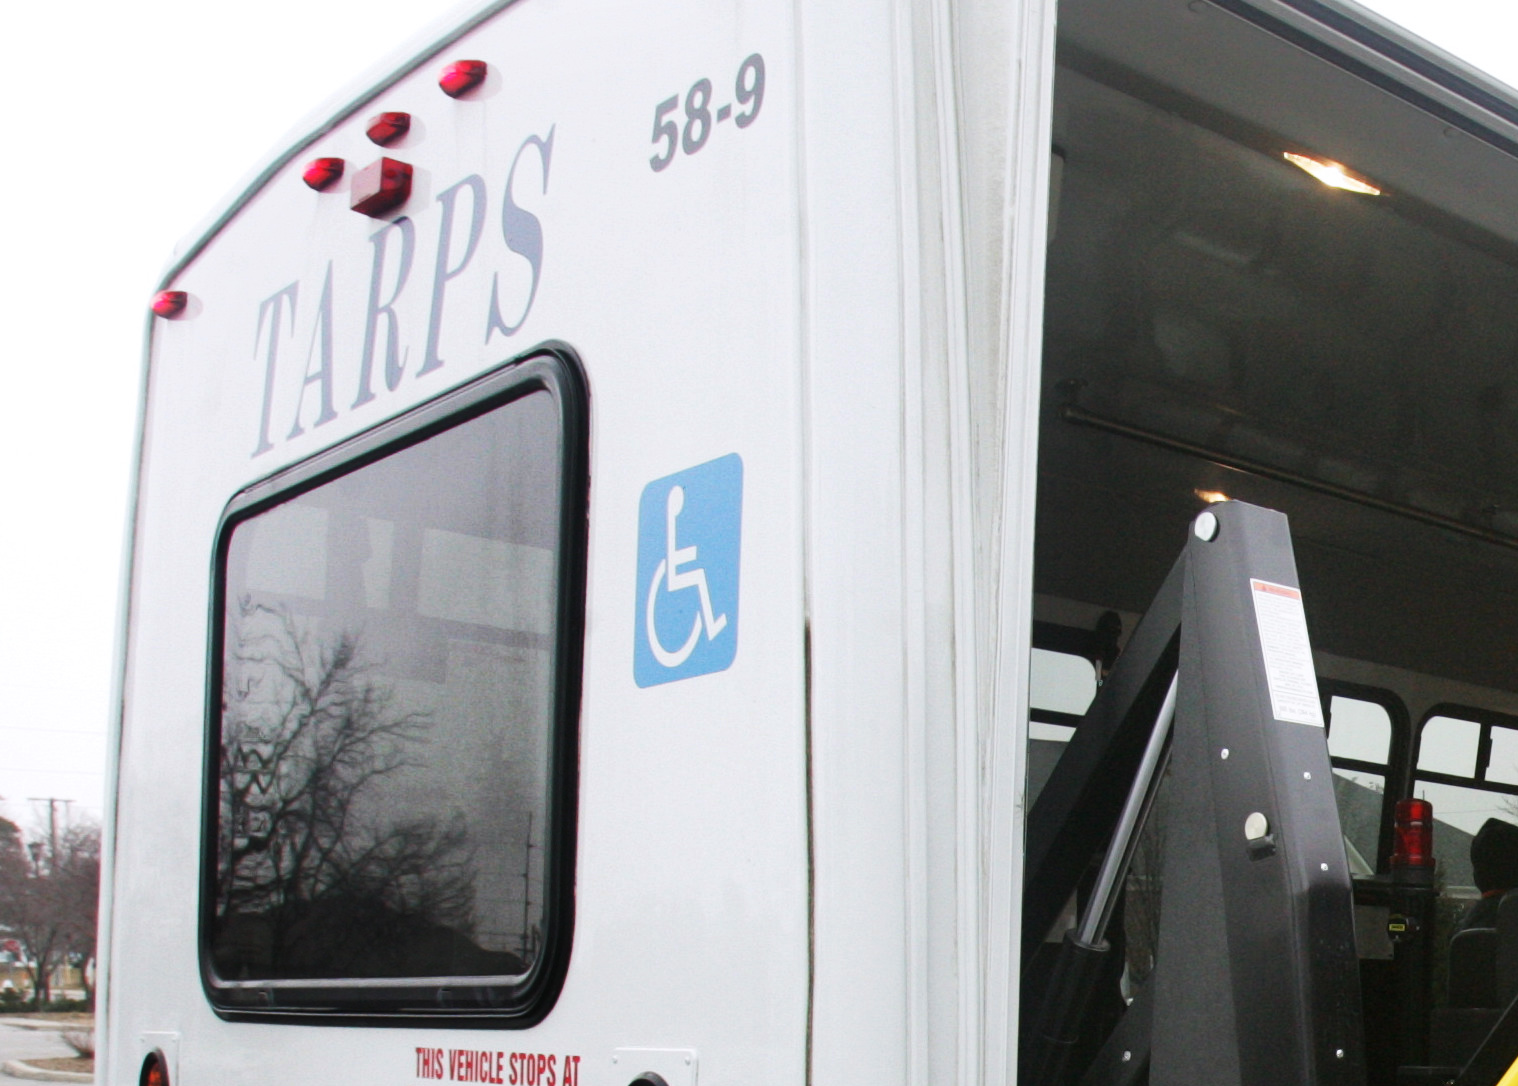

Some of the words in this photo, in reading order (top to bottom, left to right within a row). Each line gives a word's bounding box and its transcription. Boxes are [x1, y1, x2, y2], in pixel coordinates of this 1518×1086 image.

[650, 53, 765, 173] 58-9
[251, 123, 556, 459] TARPS
[415, 1047, 444, 1080] THIS
[449, 1049, 504, 1084] VEHICLE
